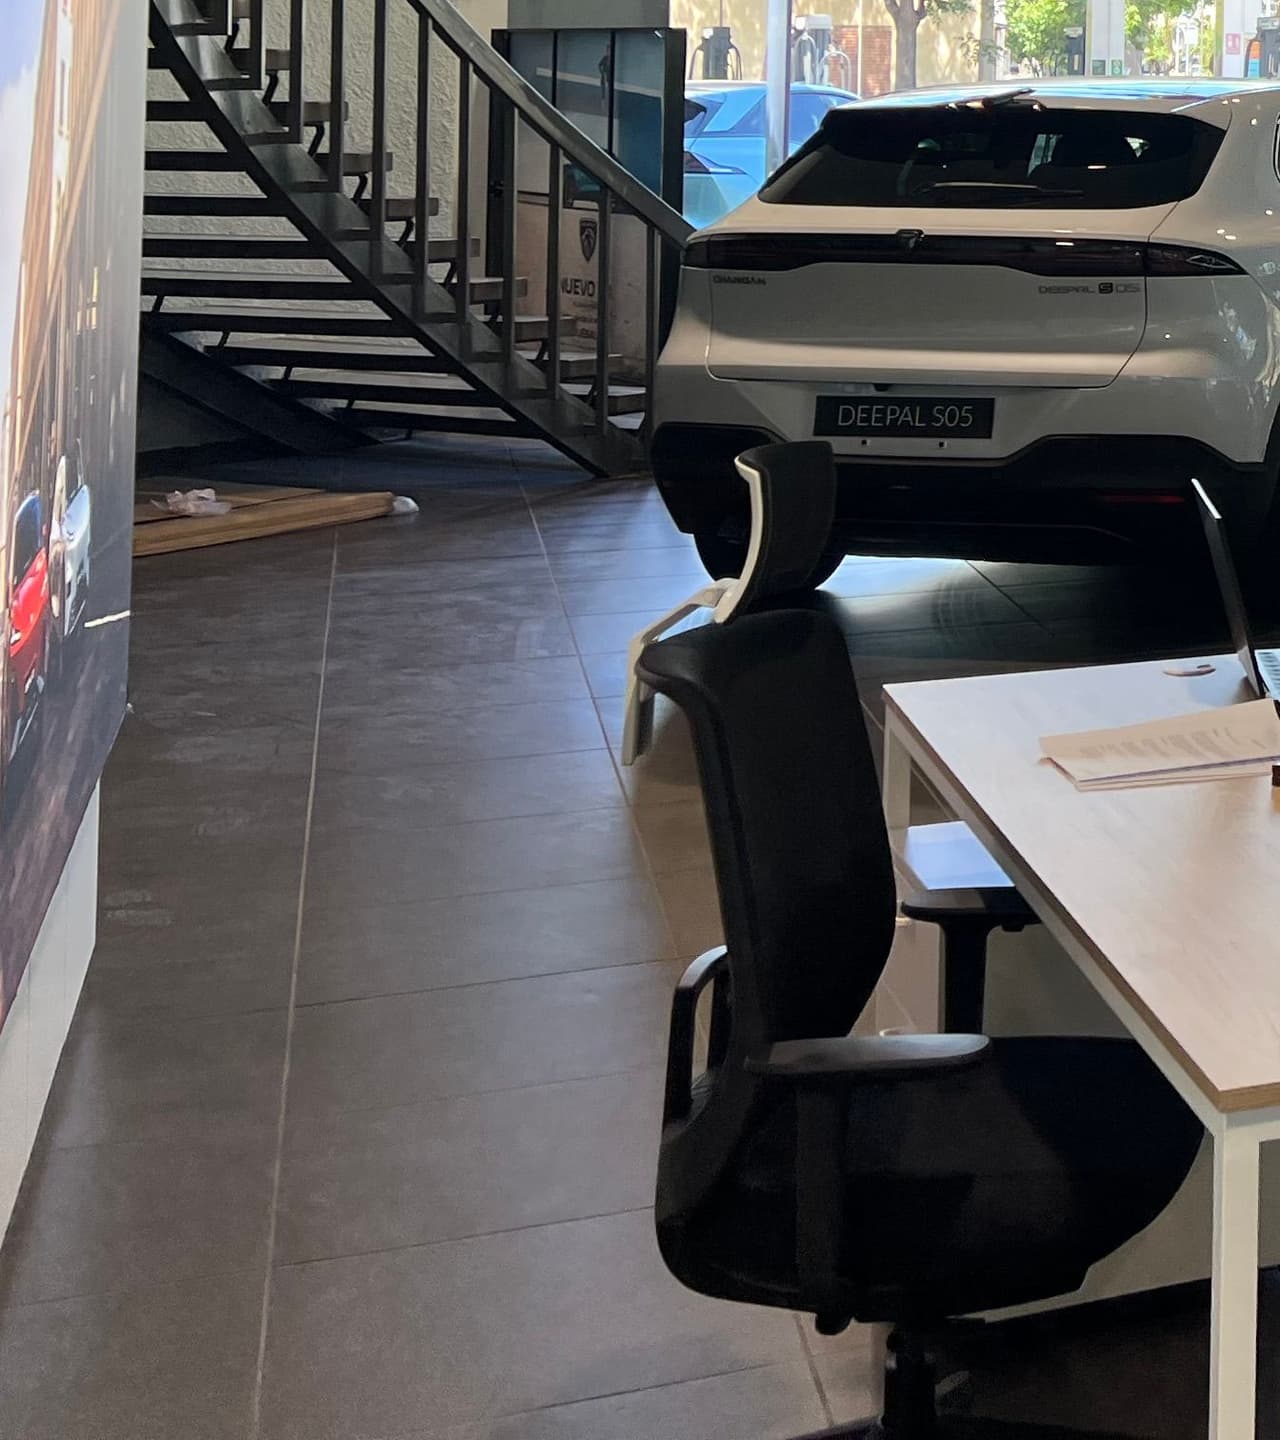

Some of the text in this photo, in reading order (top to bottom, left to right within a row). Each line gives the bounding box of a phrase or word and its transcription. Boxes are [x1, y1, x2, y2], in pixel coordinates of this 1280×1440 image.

[1038, 285, 1097, 295] DEEPAL
[837, 404, 974, 428] DEEPAL S05
